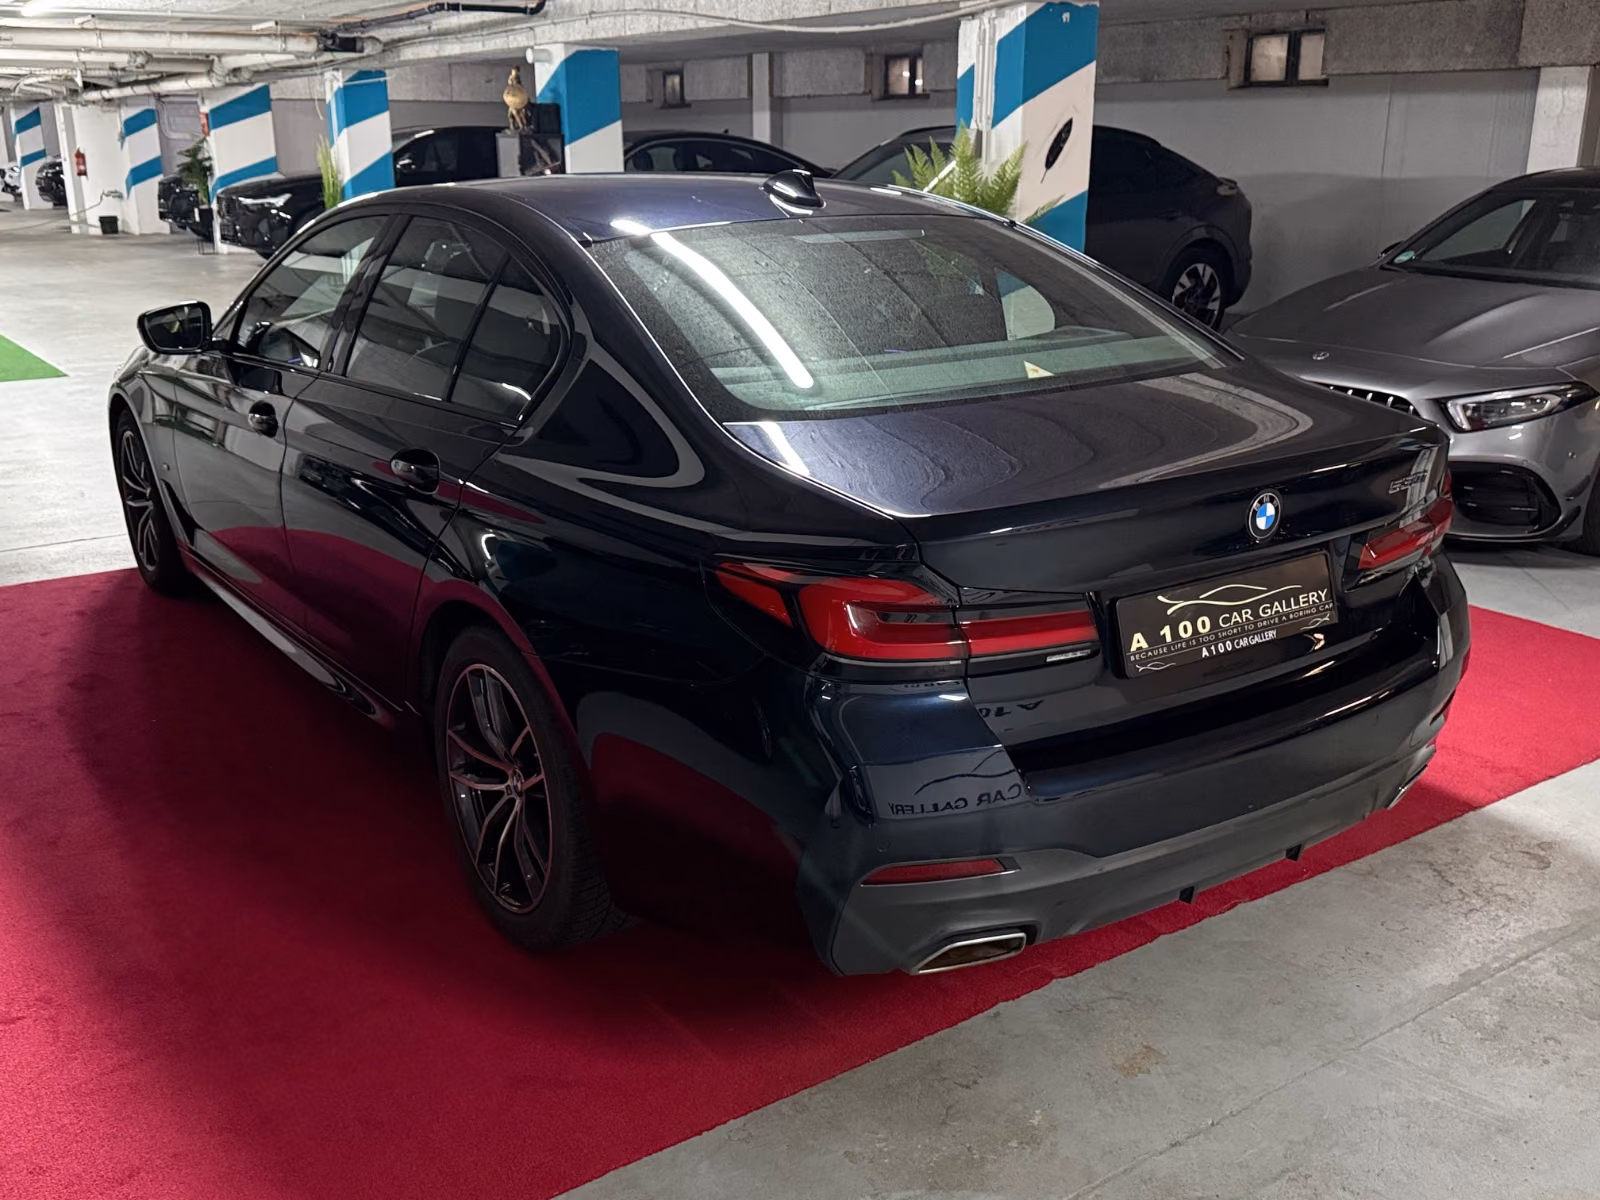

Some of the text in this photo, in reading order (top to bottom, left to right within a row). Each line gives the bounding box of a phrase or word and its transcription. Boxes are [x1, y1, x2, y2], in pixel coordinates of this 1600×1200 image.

[1130, 588, 1328, 652] A 100 CAR GALLERY
[1130, 647, 1168, 662] BECAUSE
[1171, 641, 1187, 651] LIFE
[1189, 639, 1197, 647] IS
[1199, 634, 1215, 643] TOO
[1218, 627, 1241, 638] SHORT
[1257, 617, 1279, 628] DRIVE
[1289, 607, 1317, 619] BORING
